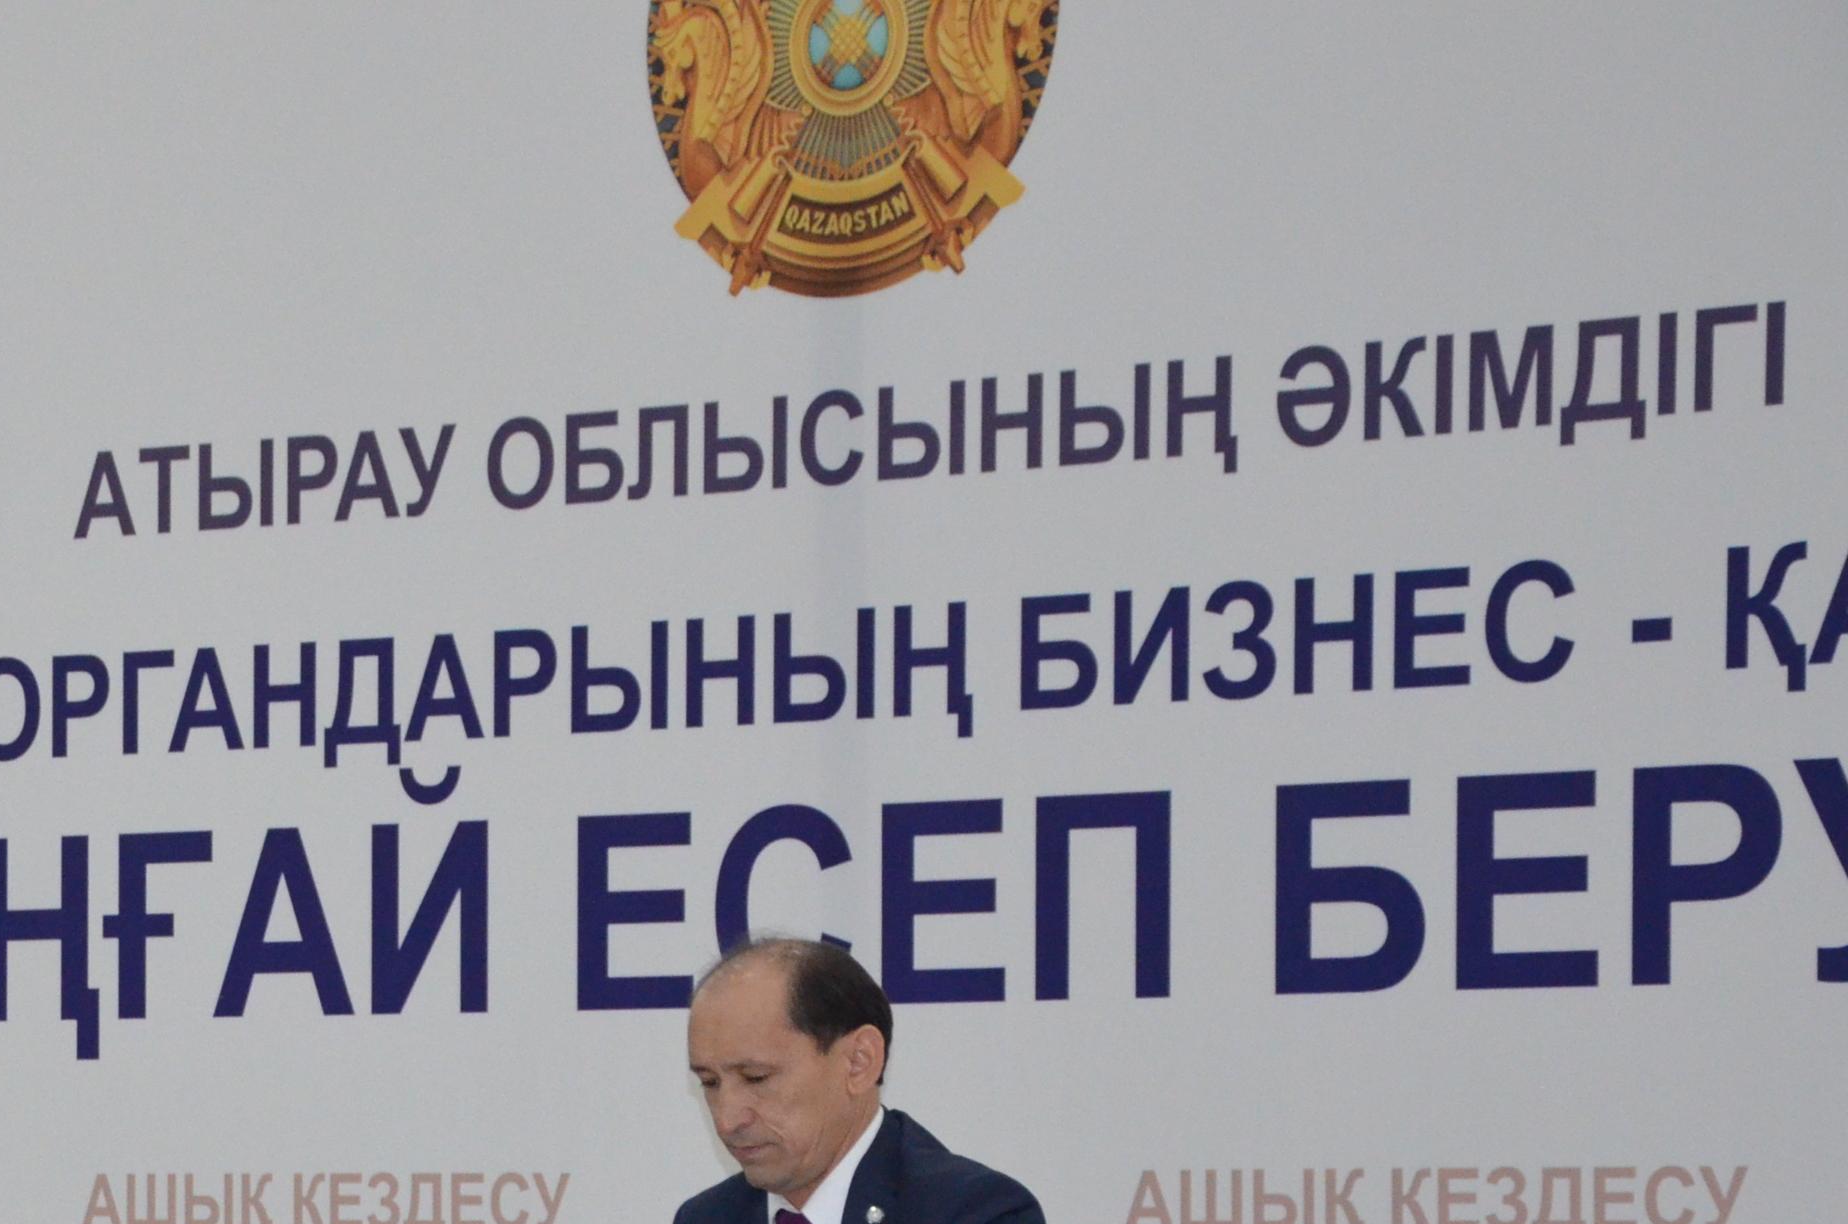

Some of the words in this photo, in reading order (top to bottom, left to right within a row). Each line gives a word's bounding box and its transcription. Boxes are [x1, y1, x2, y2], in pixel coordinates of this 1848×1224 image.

[784, 190, 911, 237] QAZAQSTAN
[73, 424, 456, 539] АТЫРАУ
[487, 356, 1238, 510] ОБЛЫСЫНЫҢ
[1276, 301, 1786, 448] ӘКІМДІГІ
[1020, 559, 1575, 711] БИЗНЕС
[576, 790, 1172, 1011] ЕСЕП
